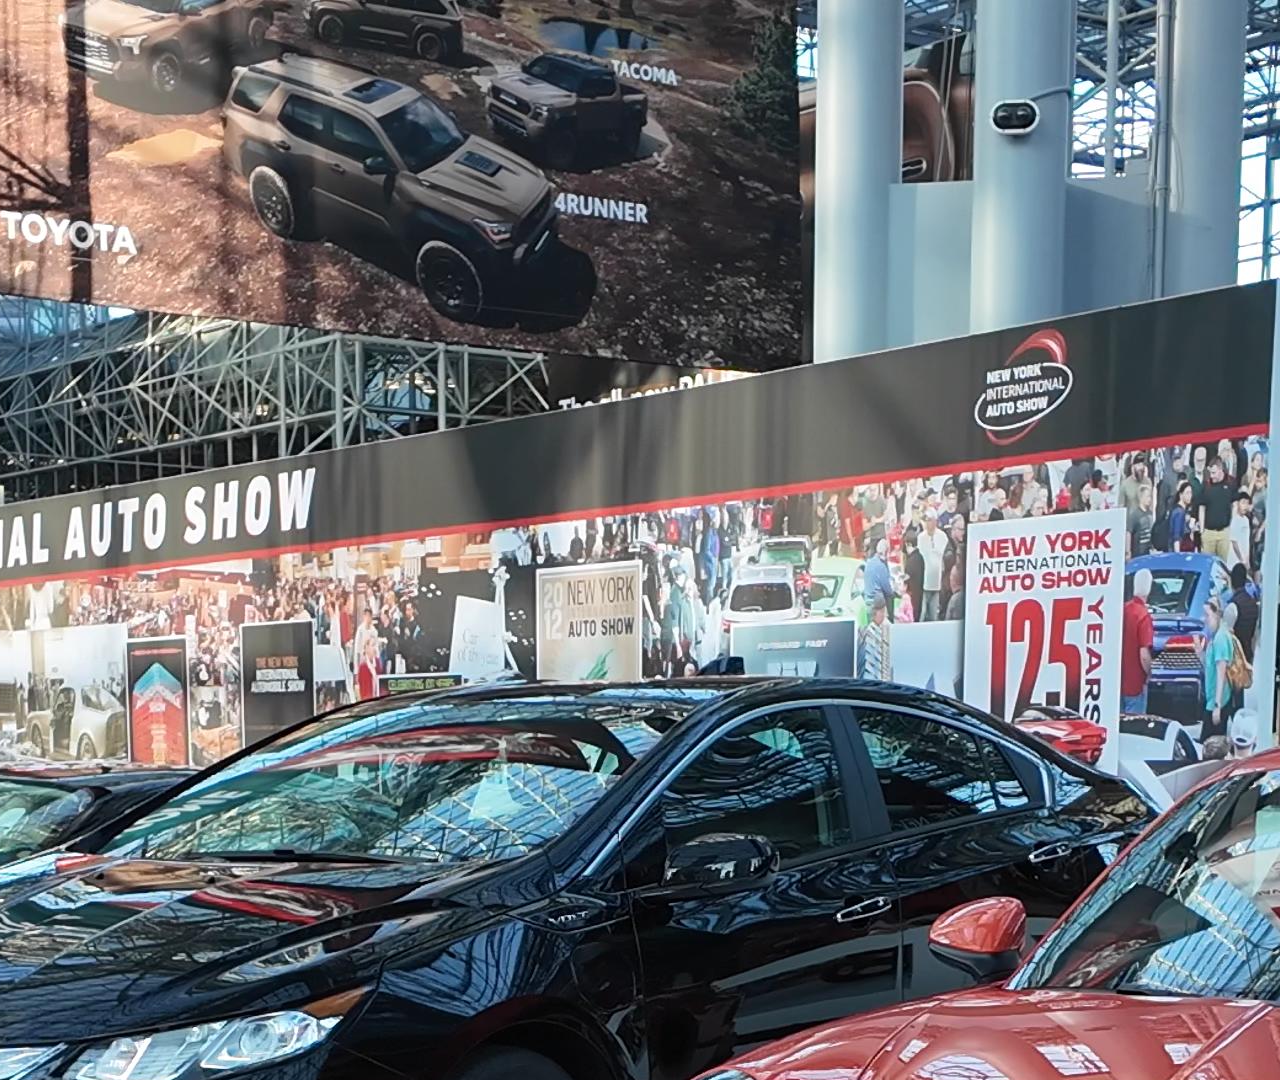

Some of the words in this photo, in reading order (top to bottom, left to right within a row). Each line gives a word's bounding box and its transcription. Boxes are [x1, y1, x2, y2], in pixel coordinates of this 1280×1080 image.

[611, 60, 678, 86] TACOMA
[554, 192, 648, 223] 4RUNNER
[0, 210, 137, 255] TOYOTA
[986, 368, 1012, 384] NEW
[1013, 363, 1041, 380] YORK
[986, 376, 1065, 401] INTERNATIONAL
[985, 401, 1014, 417] AUTO
[1016, 395, 1049, 413] SHOW
[63, 491, 167, 560] AUTO
[182, 467, 317, 545] SHOW
[978, 535, 1036, 560] NEW
[1045, 528, 1112, 554] YORK
[978, 551, 1112, 575] INTERNATIONAL
[568, 580, 596, 606] NEW
[599, 575, 635, 603] YORK
[978, 573, 1035, 594] AUTO
[1041, 566, 1112, 590] SHOW
[568, 619, 596, 638] AUTO
[600, 616, 635, 637] SHOW
[985, 597, 1084, 724] 125
[1083, 595, 1105, 724] YEARS
